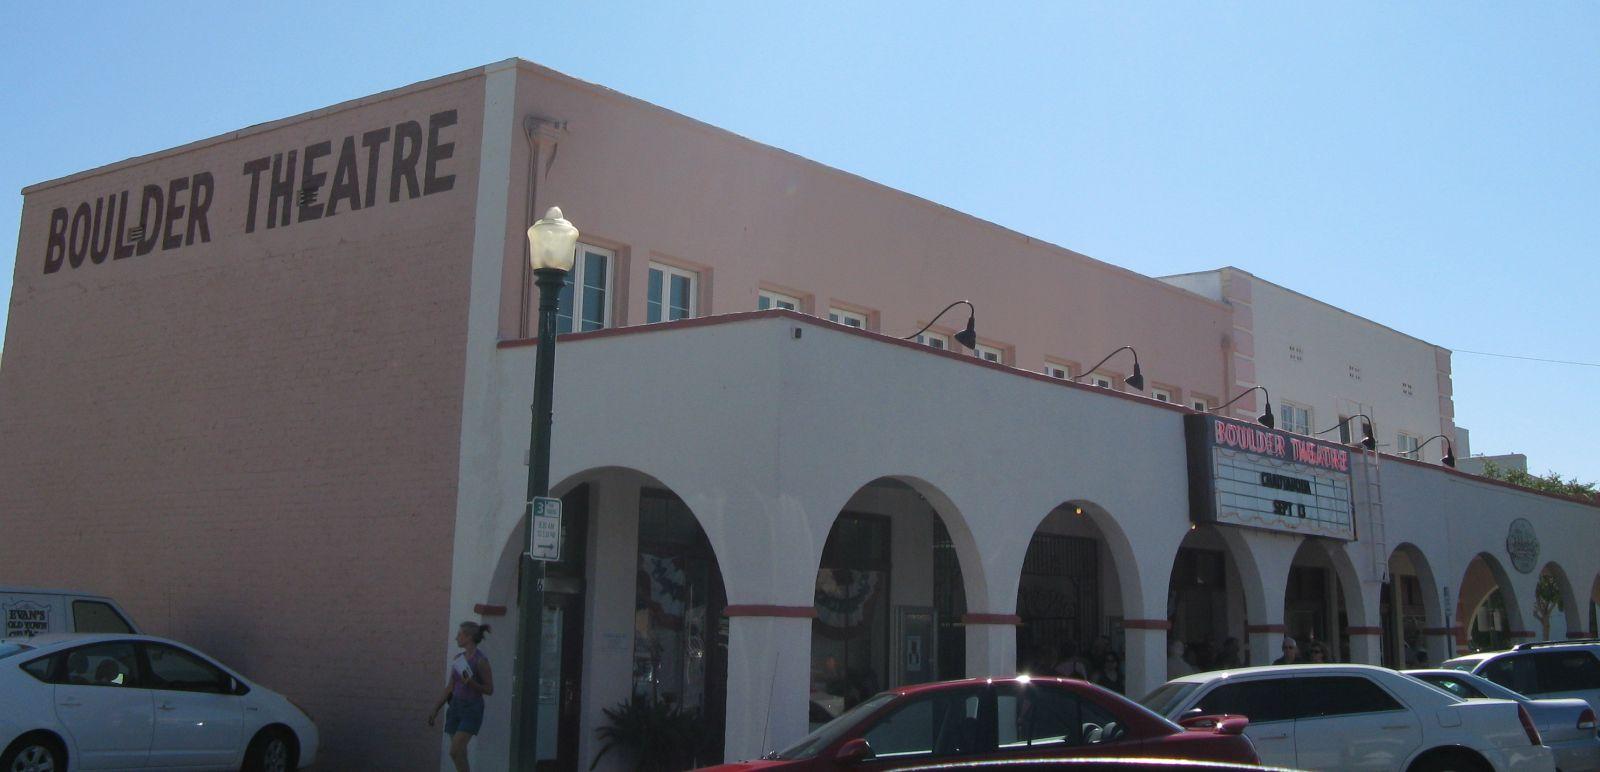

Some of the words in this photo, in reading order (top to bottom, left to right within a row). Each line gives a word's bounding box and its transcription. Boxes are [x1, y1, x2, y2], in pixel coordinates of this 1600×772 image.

[43, 171, 215, 275] BOULDER
[243, 109, 458, 234] THEATRE
[1214, 420, 1286, 458] BOULDER
[1290, 438, 1348, 472] THEATRE
[537, 502, 544, 514] 3
[8, 609, 45, 620] EVAN'S
[7, 620, 23, 628] OLD
